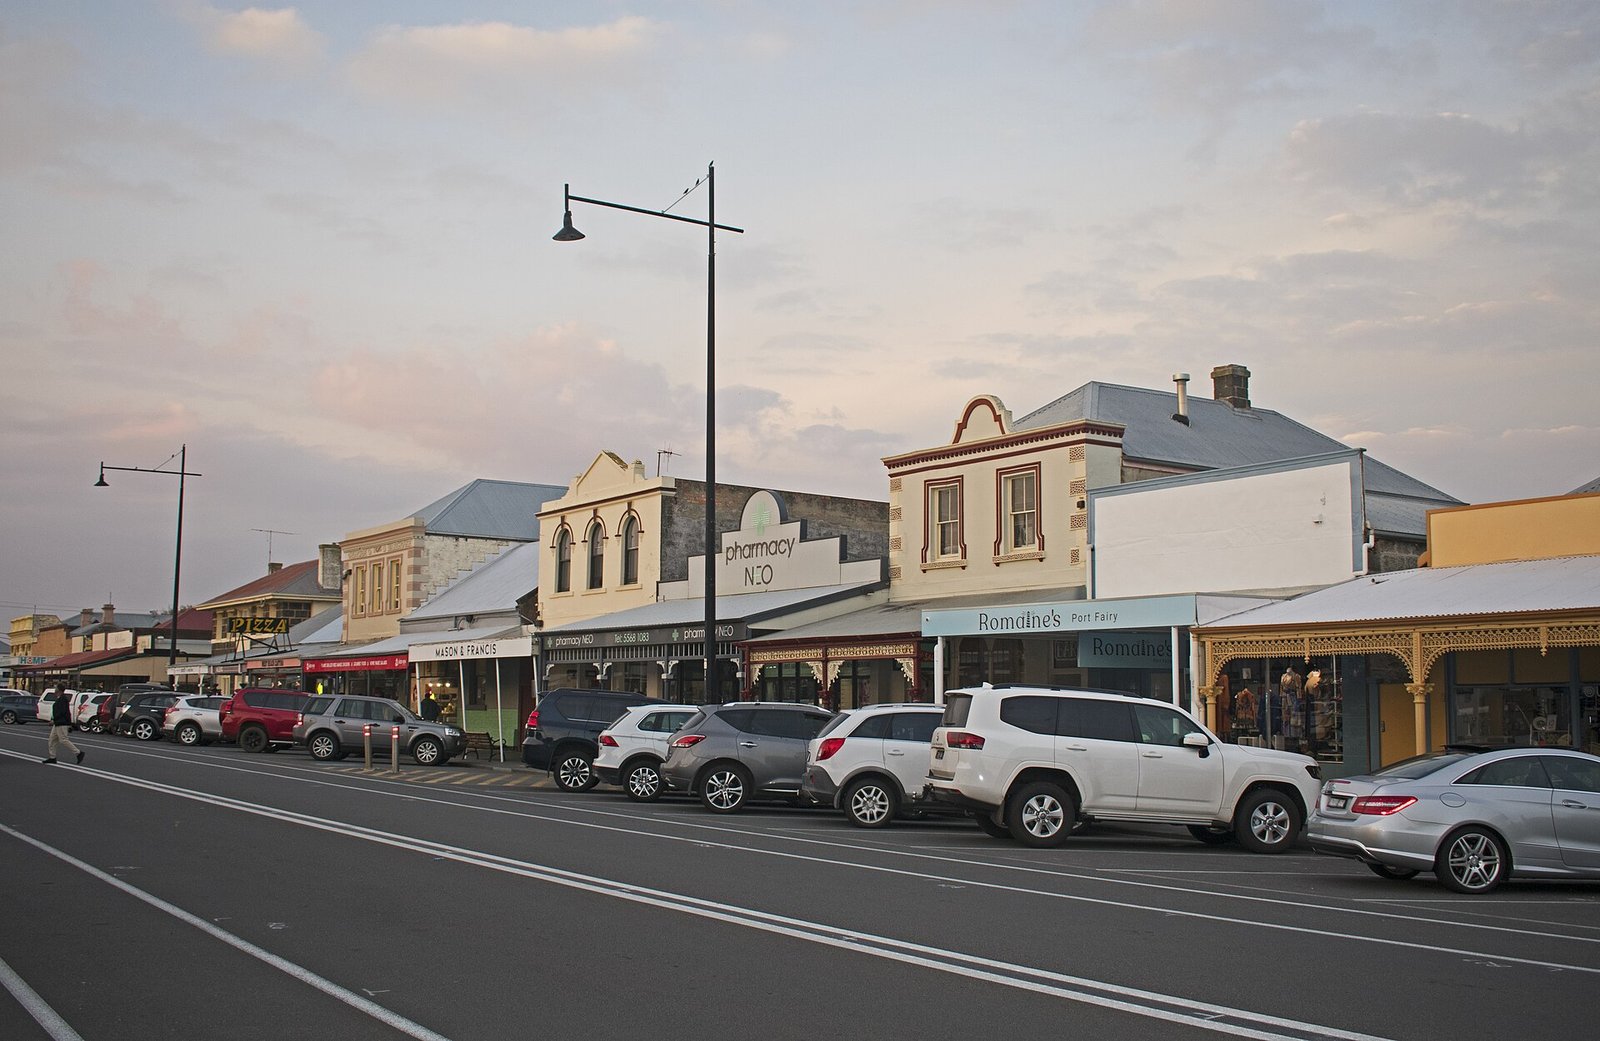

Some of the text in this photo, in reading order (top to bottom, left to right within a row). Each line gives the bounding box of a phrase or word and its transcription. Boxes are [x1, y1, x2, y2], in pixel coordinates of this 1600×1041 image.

[725, 537, 796, 566] pharmacy
[744, 564, 774, 587] NEO
[230, 617, 287, 633] PIZZA
[979, 609, 1119, 631] Romaine's Port Fairy
[623, 632, 636, 643] 5568
[637, 632, 650, 642] 1083
[718, 625, 734, 637] NEO
[555, 634, 594, 648] pharmacy NEO
[435, 643, 497, 657] MASON & FRANCIS
